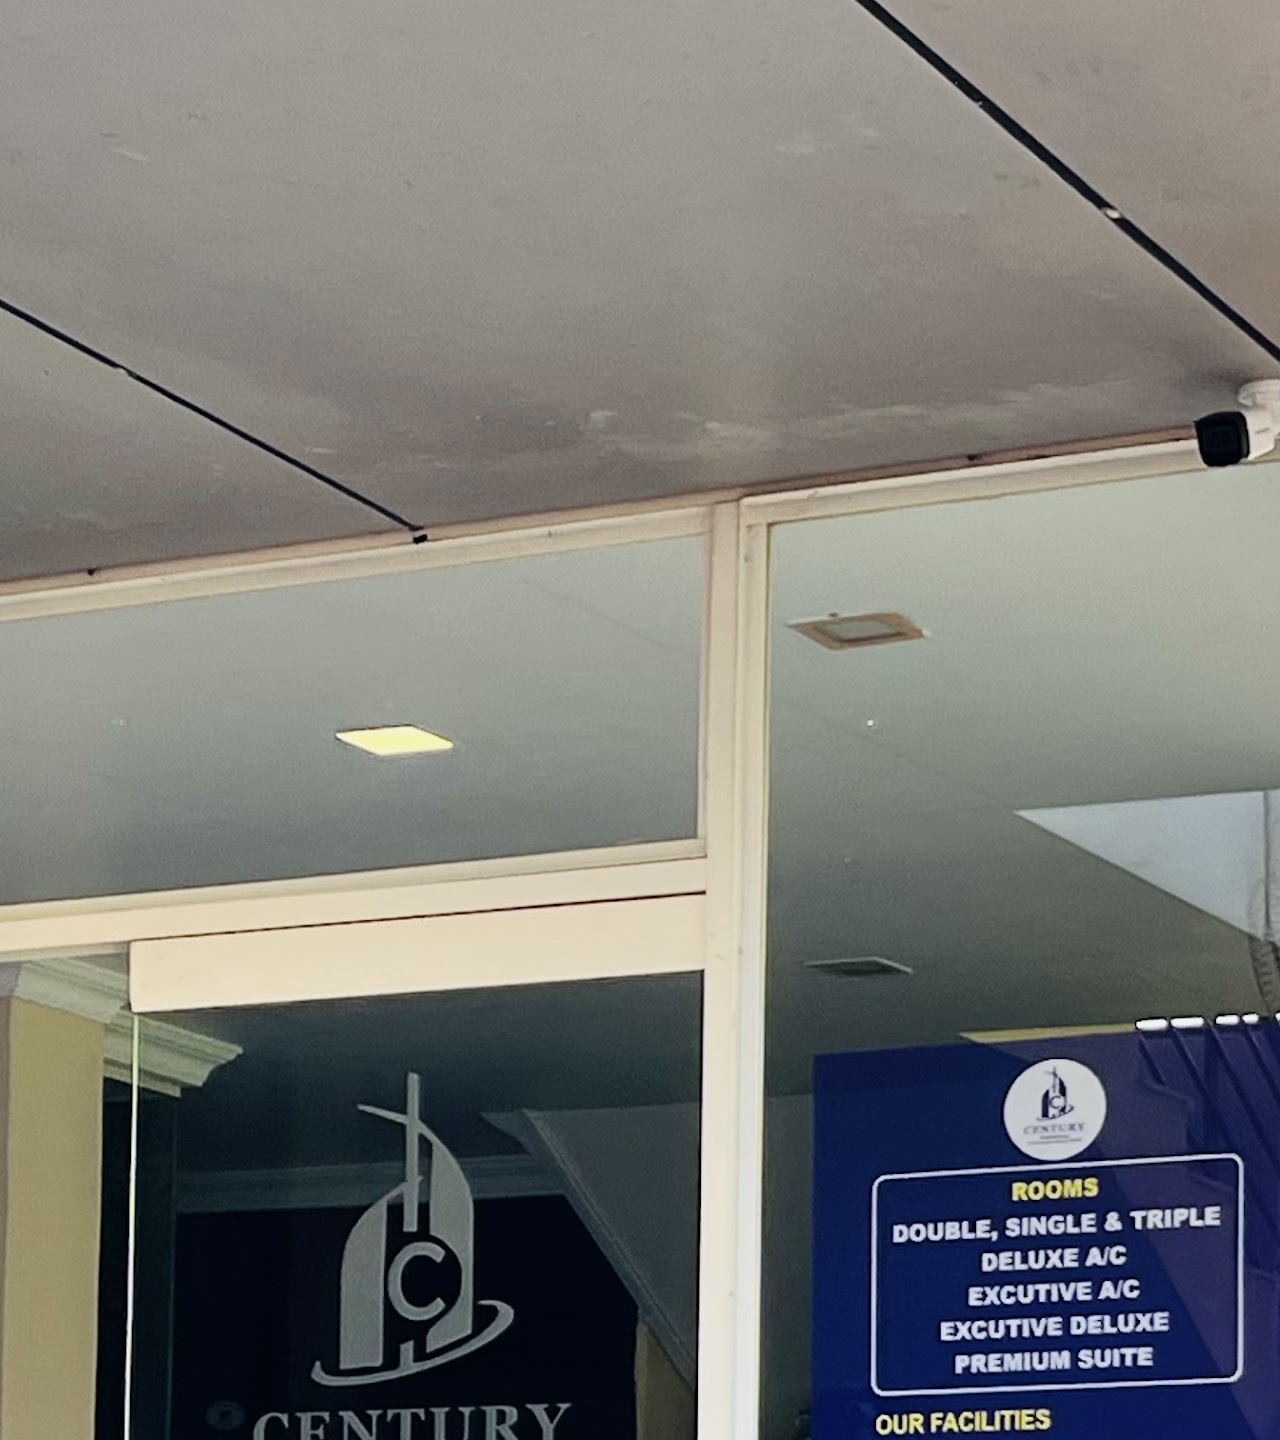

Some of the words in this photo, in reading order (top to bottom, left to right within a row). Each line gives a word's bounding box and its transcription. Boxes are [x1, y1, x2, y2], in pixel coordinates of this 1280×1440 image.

[1012, 1178, 1098, 1201] ROOMS
[893, 1219, 998, 1242] DOUBLE,
[1005, 1213, 1097, 1237] SINGLE
[1104, 1212, 1122, 1231] &
[1130, 1206, 1220, 1229] TRIPLE
[982, 1249, 1079, 1271] DELUXE
[1085, 1246, 1126, 1266] A/C
[968, 1282, 1092, 1306] EXCUTIVE
[1098, 1279, 1140, 1299] A/C
[941, 1317, 1062, 1341] EXCUTIVE
[1070, 1312, 1169, 1334] DELUXE
[955, 1350, 1070, 1373] PREMIUM
[1078, 1347, 1153, 1368] SUITE
[876, 1413, 924, 1435] OUR
[931, 1409, 1051, 1433] FACILITIES
